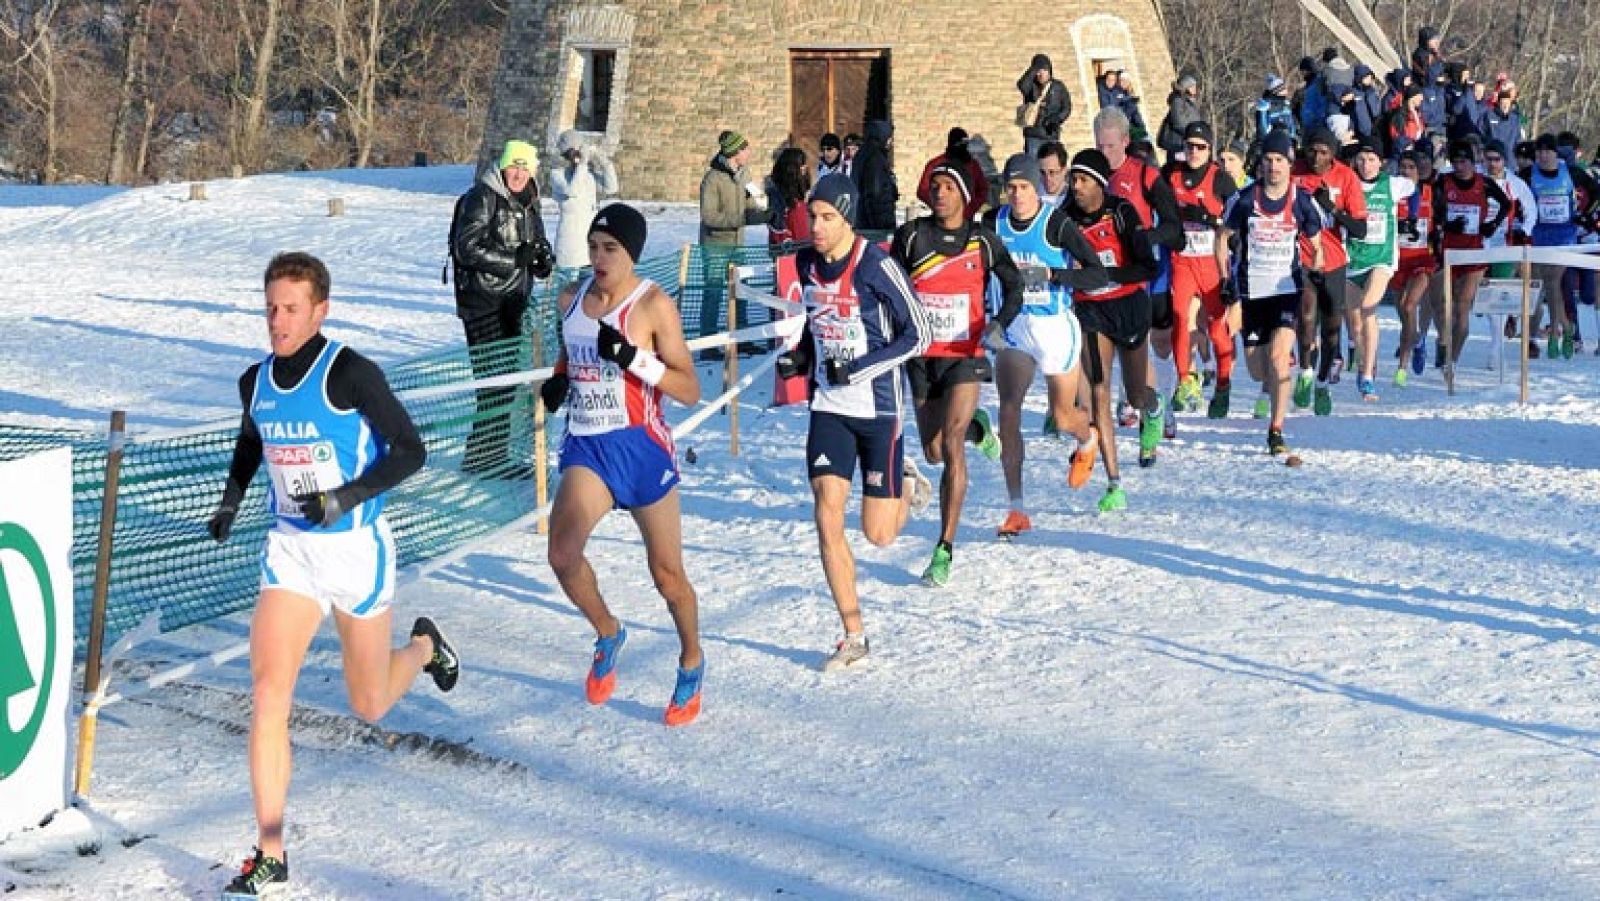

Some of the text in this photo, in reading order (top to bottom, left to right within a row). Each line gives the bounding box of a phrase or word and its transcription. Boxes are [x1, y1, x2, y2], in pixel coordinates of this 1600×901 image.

[260, 420, 321, 439] ITALIA
[264, 447, 313, 465] SPAR
[280, 470, 321, 497] Lalli
